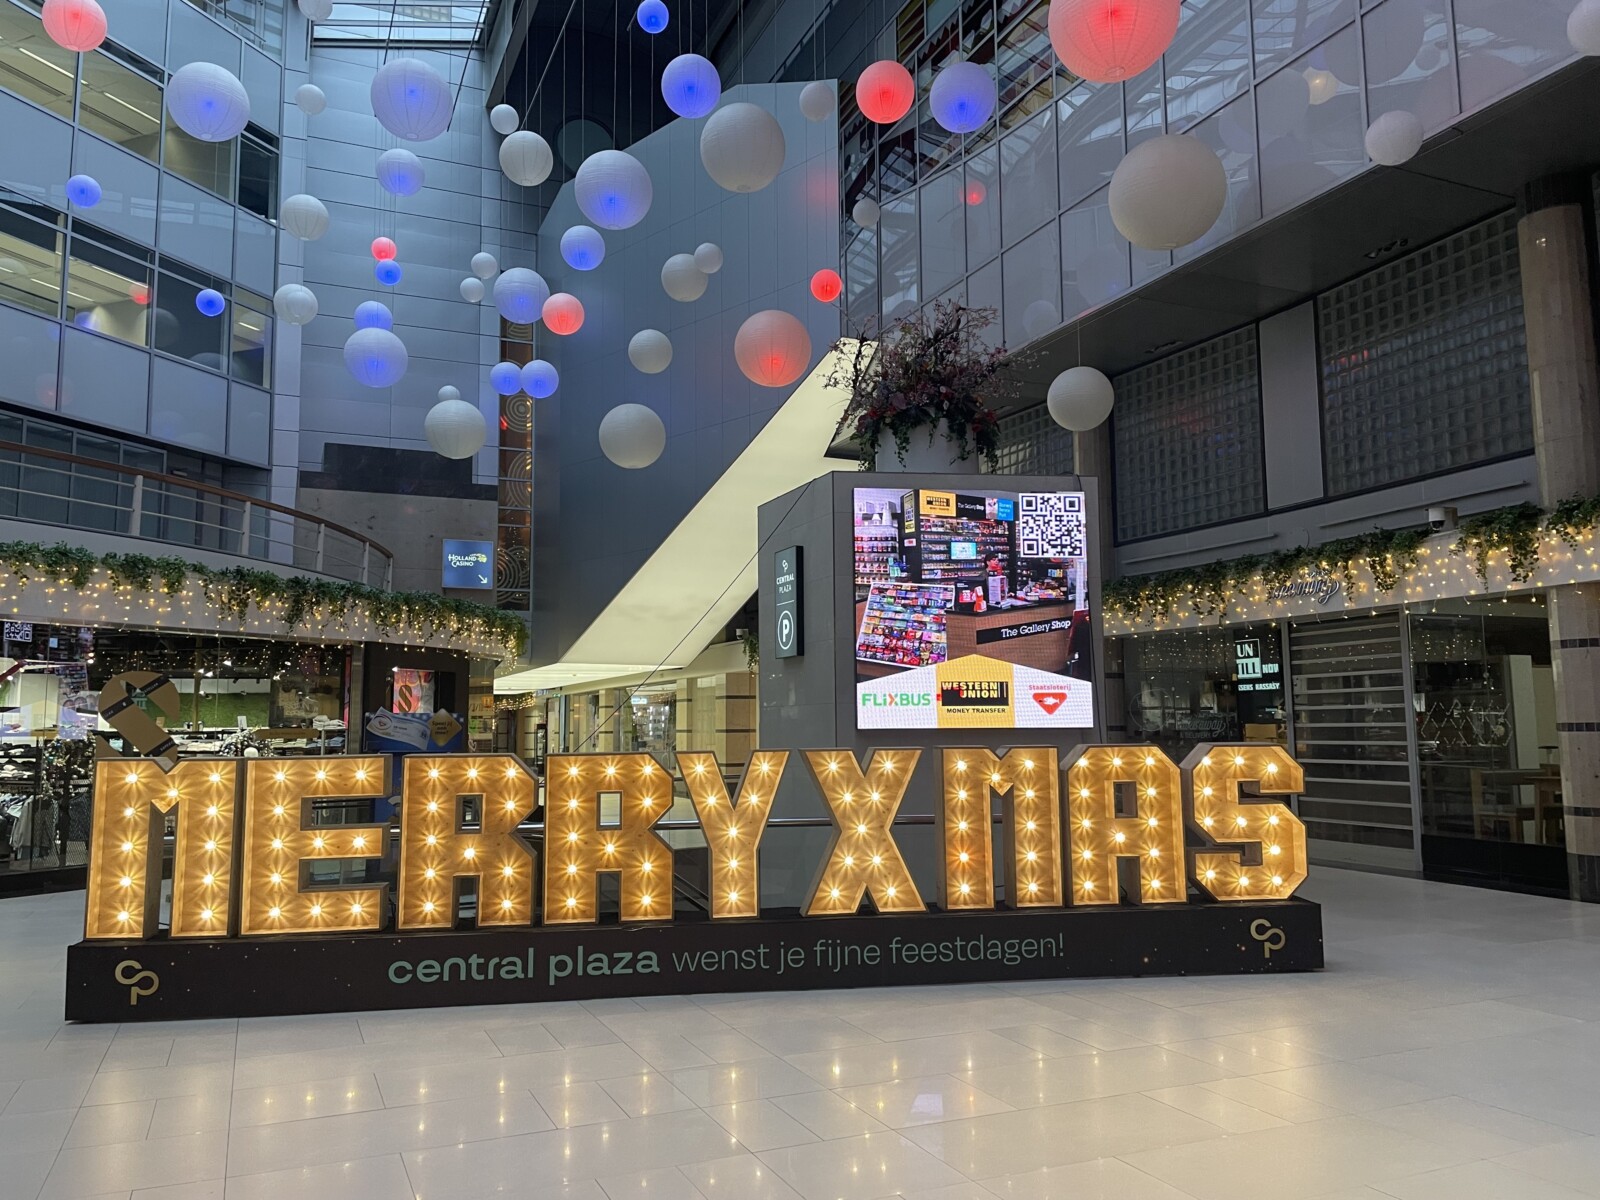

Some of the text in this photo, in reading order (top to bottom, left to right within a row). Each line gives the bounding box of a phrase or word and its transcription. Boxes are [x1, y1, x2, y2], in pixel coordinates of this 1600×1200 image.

[448, 553, 477, 561] HOLLAND
[451, 560, 474, 568] CASINO
[776, 573, 795, 585] CENTRAL
[779, 584, 792, 594] PLAZA
[1001, 620, 1072, 638] The Gallery Shop
[941, 681, 998, 691] WESTERN
[960, 689, 998, 699] UNION
[802, 744, 1308, 917] XMAS
[84, 750, 789, 940] MERRY
[388, 932, 1064, 987] central plaza wenst je fijne feestdagen!
